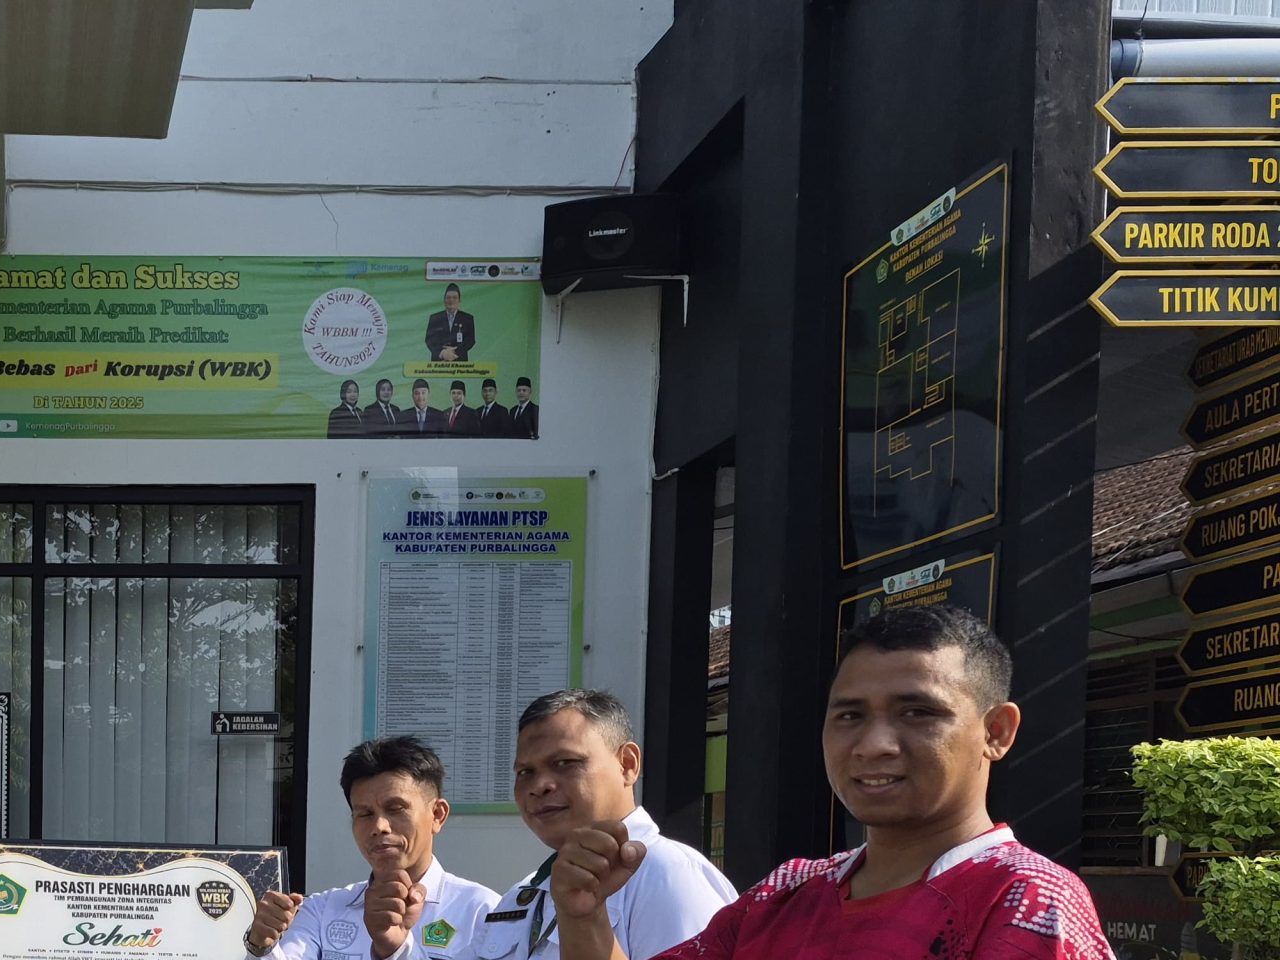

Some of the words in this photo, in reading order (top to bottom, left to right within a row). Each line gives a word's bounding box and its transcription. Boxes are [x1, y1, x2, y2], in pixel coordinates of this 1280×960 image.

[1124, 222, 1205, 249] PARKIR
[1211, 222, 1270, 248] RODA
[72, 263, 129, 289] dan
[134, 264, 240, 290] Sukses
[1158, 287, 1220, 313] TITIK
[94, 299, 157, 320] Agama
[160, 299, 269, 320] Purbalingga
[303, 299, 326, 335] Kami
[327, 290, 354, 307] Siap
[357, 294, 384, 335] Menuju
[3, 326, 76, 342] Berhasil
[80, 326, 145, 343] Meraih
[149, 326, 229, 343] Predikat:
[322, 327, 358, 337] WBBM
[104, 360, 195, 381] Korupsi
[199, 359, 272, 381] (WBK)
[52, 396, 107, 409] TAHUN
[110, 396, 144, 409] 2025
[1205, 399, 1240, 433] AULA
[406, 511, 445, 527] JENIS
[448, 511, 509, 527] LAYANAN
[511, 510, 548, 527] PTSP
[383, 532, 432, 541] KANTOR
[437, 532, 523, 541] KEMENTERIAN
[526, 531, 570, 541] AGAMA
[1201, 513, 1246, 547] RUANG
[395, 543, 467, 553] KABUPATEN
[470, 543, 556, 553] PURBALINGGA
[232, 723, 278, 731] KEBERSIHAN
[35, 880, 94, 894] PRASASTI
[99, 882, 190, 897] PENGHARGAAN
[67, 895, 116, 903] PEMBANGUNAN
[201, 893, 230, 904] WBK
[109, 912, 154, 920] PURBALINGGA
[62, 922, 162, 947] Sehati
[1107, 921, 1157, 942] HEMAT
